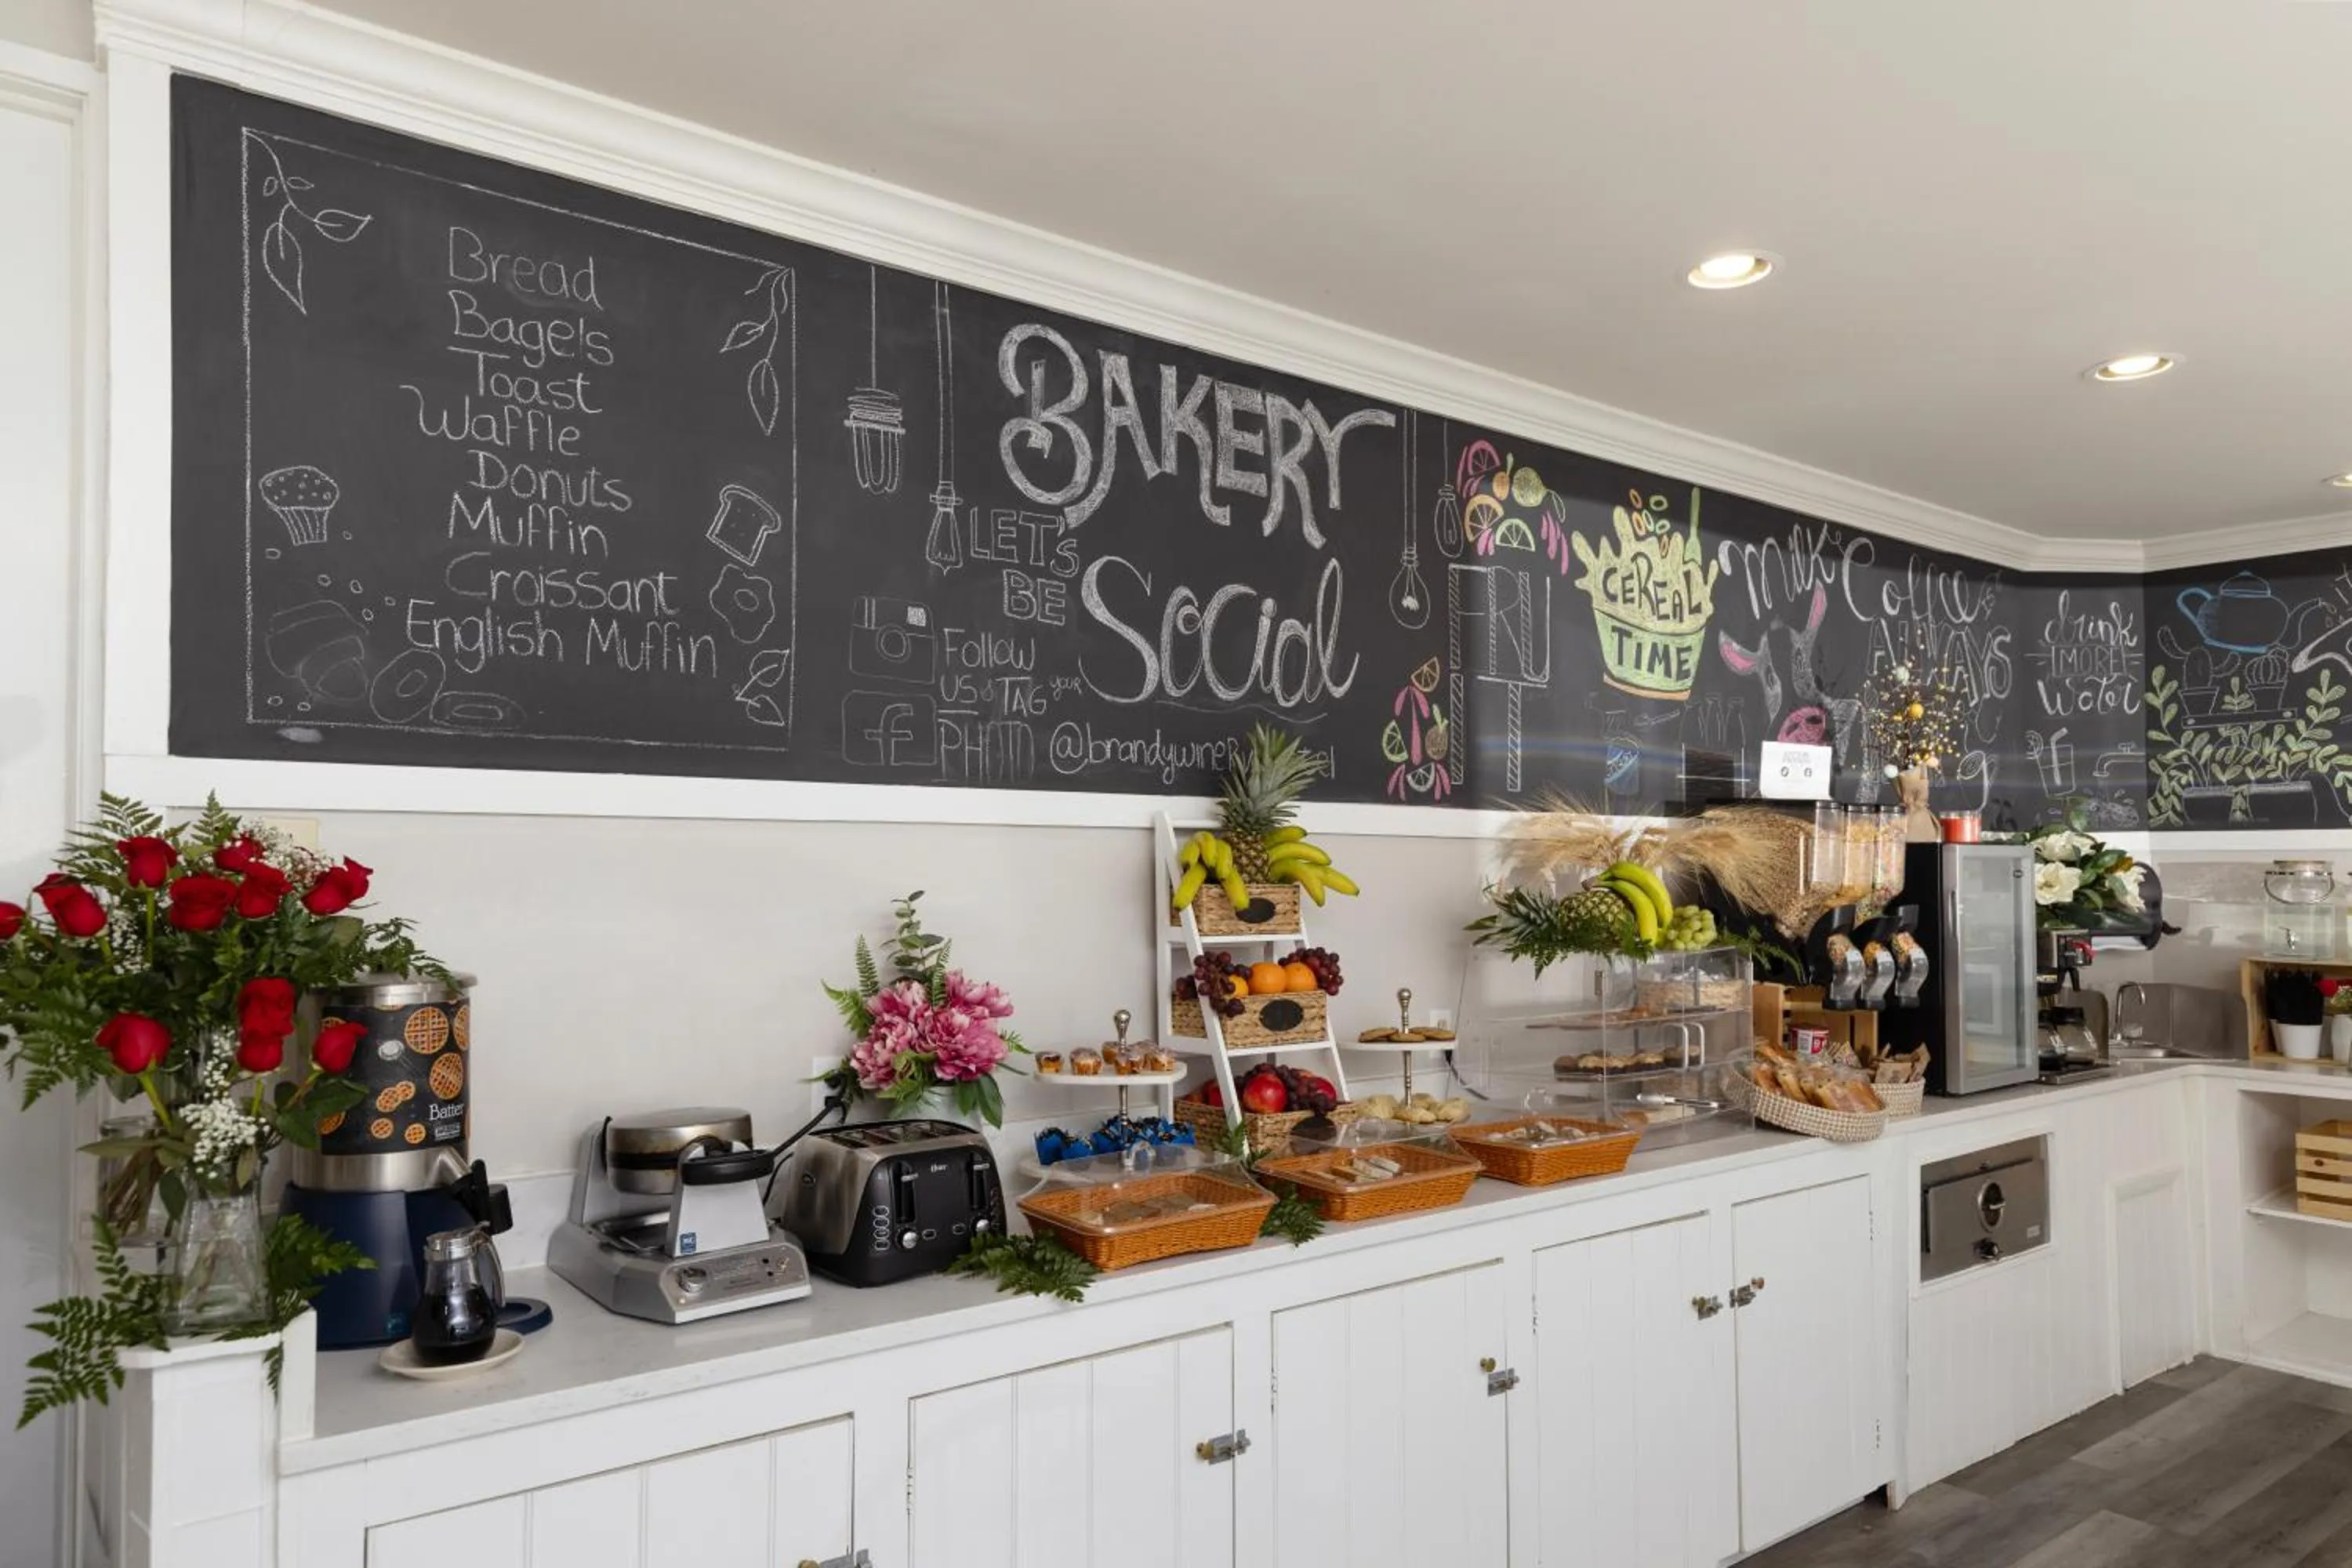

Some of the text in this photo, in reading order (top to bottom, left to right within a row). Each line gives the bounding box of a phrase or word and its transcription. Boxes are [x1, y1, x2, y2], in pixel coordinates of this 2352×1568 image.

[449, 227, 604, 310] Bread
[448, 289, 614, 367] Bagels
[447, 347, 602, 413] Toast
[399, 385, 581, 456] Waffle
[998, 323, 1396, 550] BAKERY
[467, 449, 633, 511] Donuts
[448, 492, 608, 558] Muffin
[970, 507, 1080, 578] LET'S
[446, 551, 679, 616] Croissant
[1003, 569, 1066, 626] BE
[405, 599, 717, 678] English Muffin
[943, 628, 1036, 671] Follow
[1078, 554, 1360, 707] Social
[2059, 646, 2122, 676] MORE
[995, 677, 1047, 717] TAG
